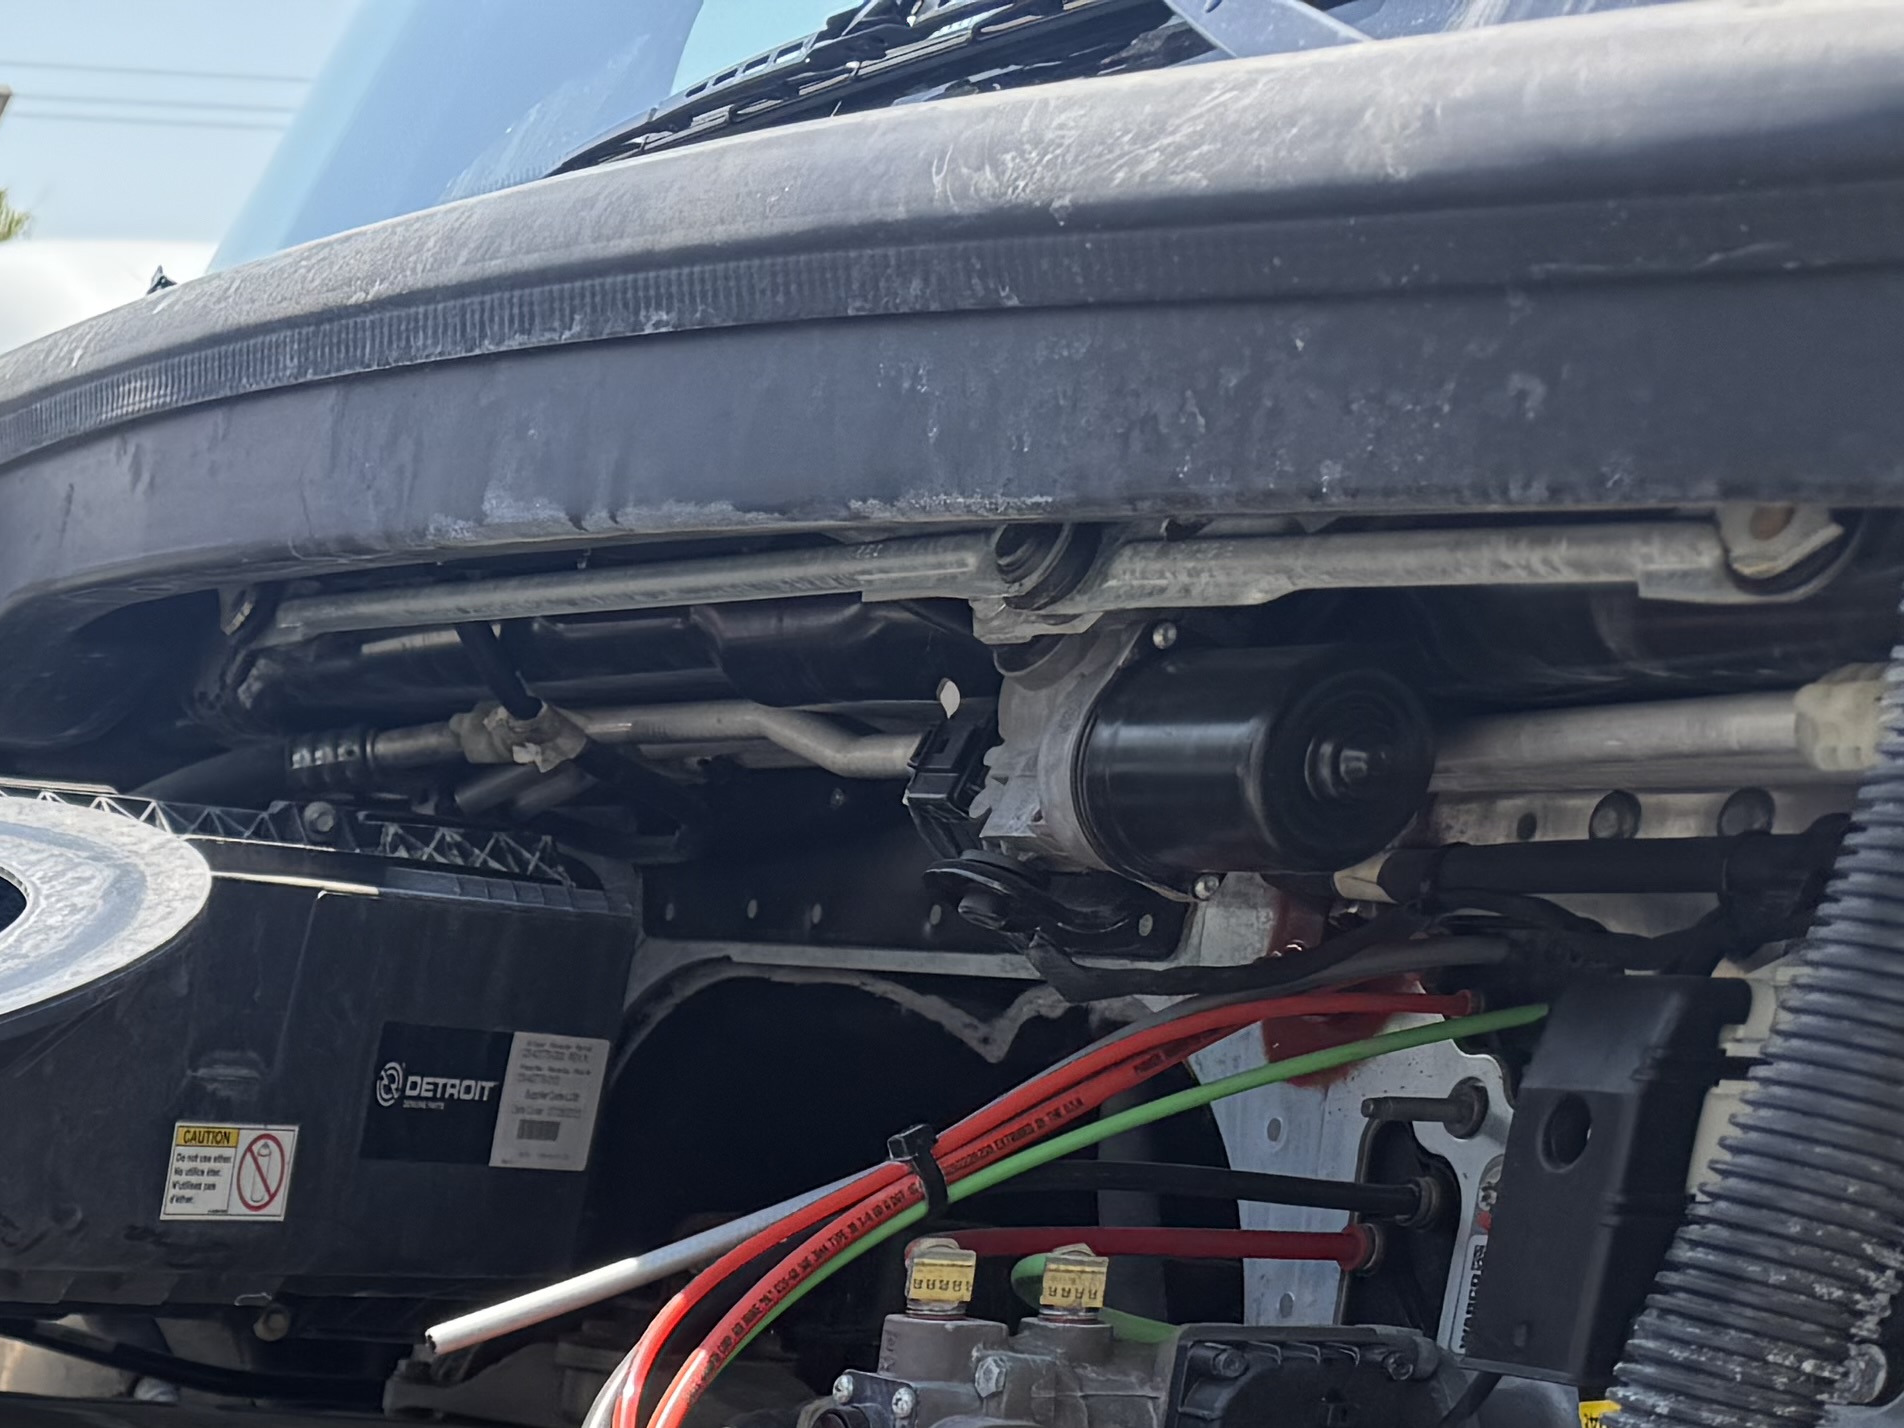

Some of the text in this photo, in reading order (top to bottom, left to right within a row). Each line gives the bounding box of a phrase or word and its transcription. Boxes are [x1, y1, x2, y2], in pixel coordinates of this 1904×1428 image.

[405, 1075, 499, 1101] DETROIT
[183, 1130, 231, 1145] CAUTION
[187, 1153, 198, 1163] not
[200, 1155, 211, 1163] use
